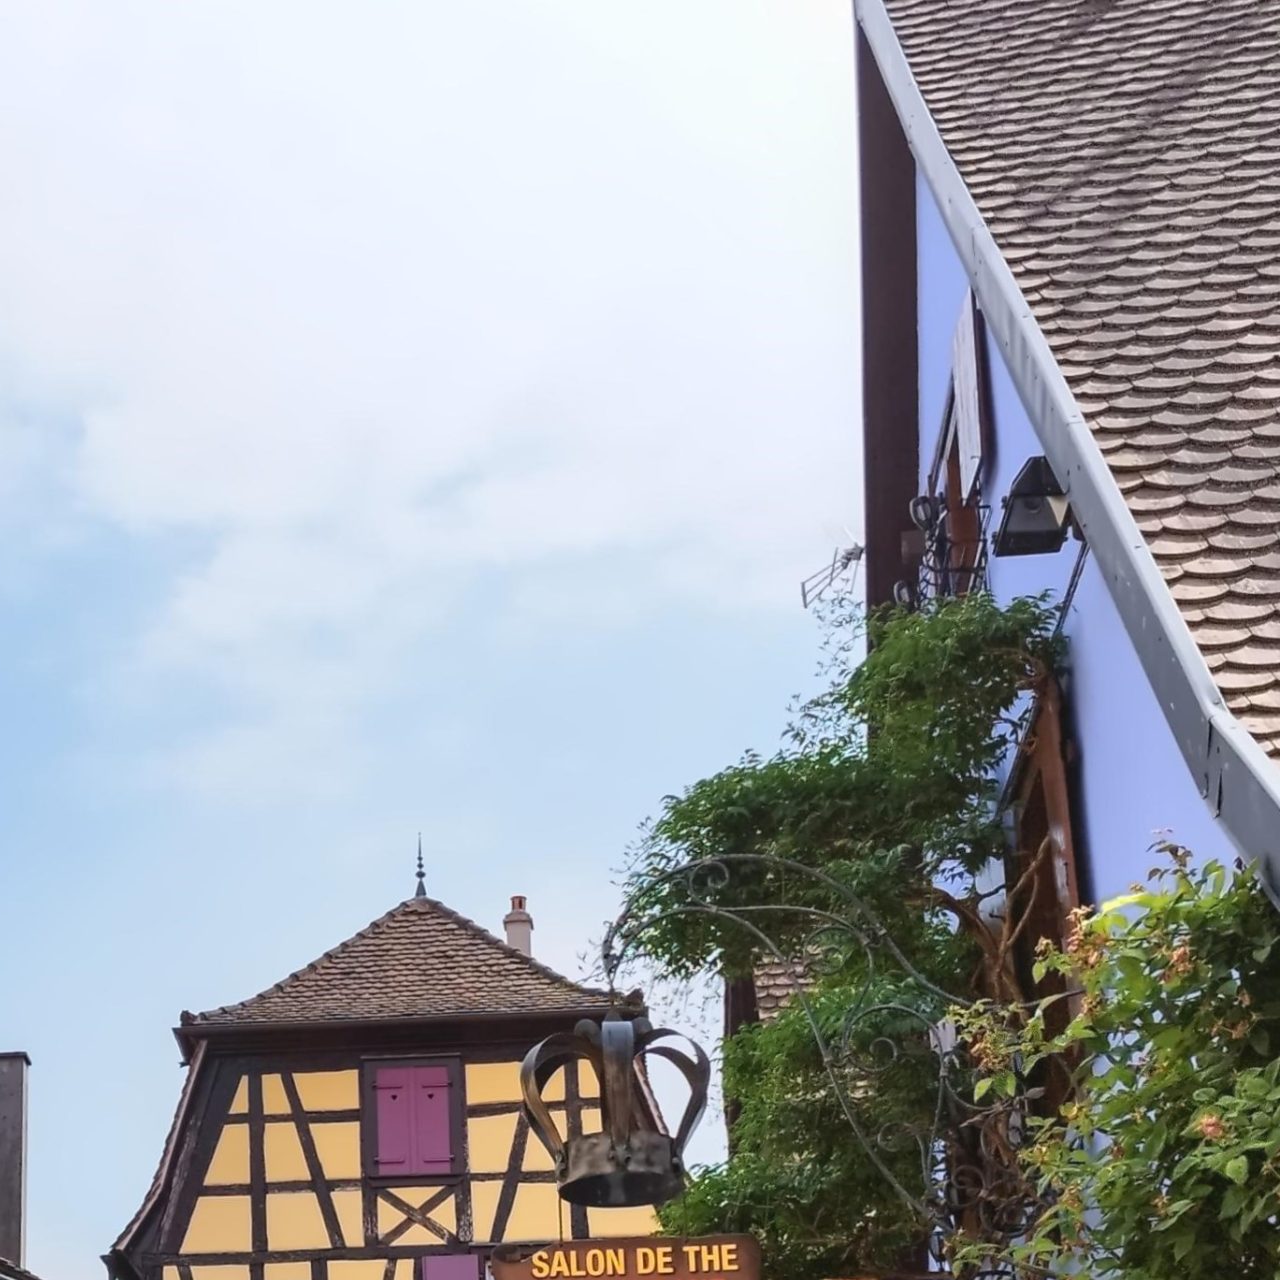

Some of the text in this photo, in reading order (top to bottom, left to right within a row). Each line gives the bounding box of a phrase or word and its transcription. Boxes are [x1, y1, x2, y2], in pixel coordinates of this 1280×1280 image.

[531, 1243, 739, 1279] SALON DE THE
